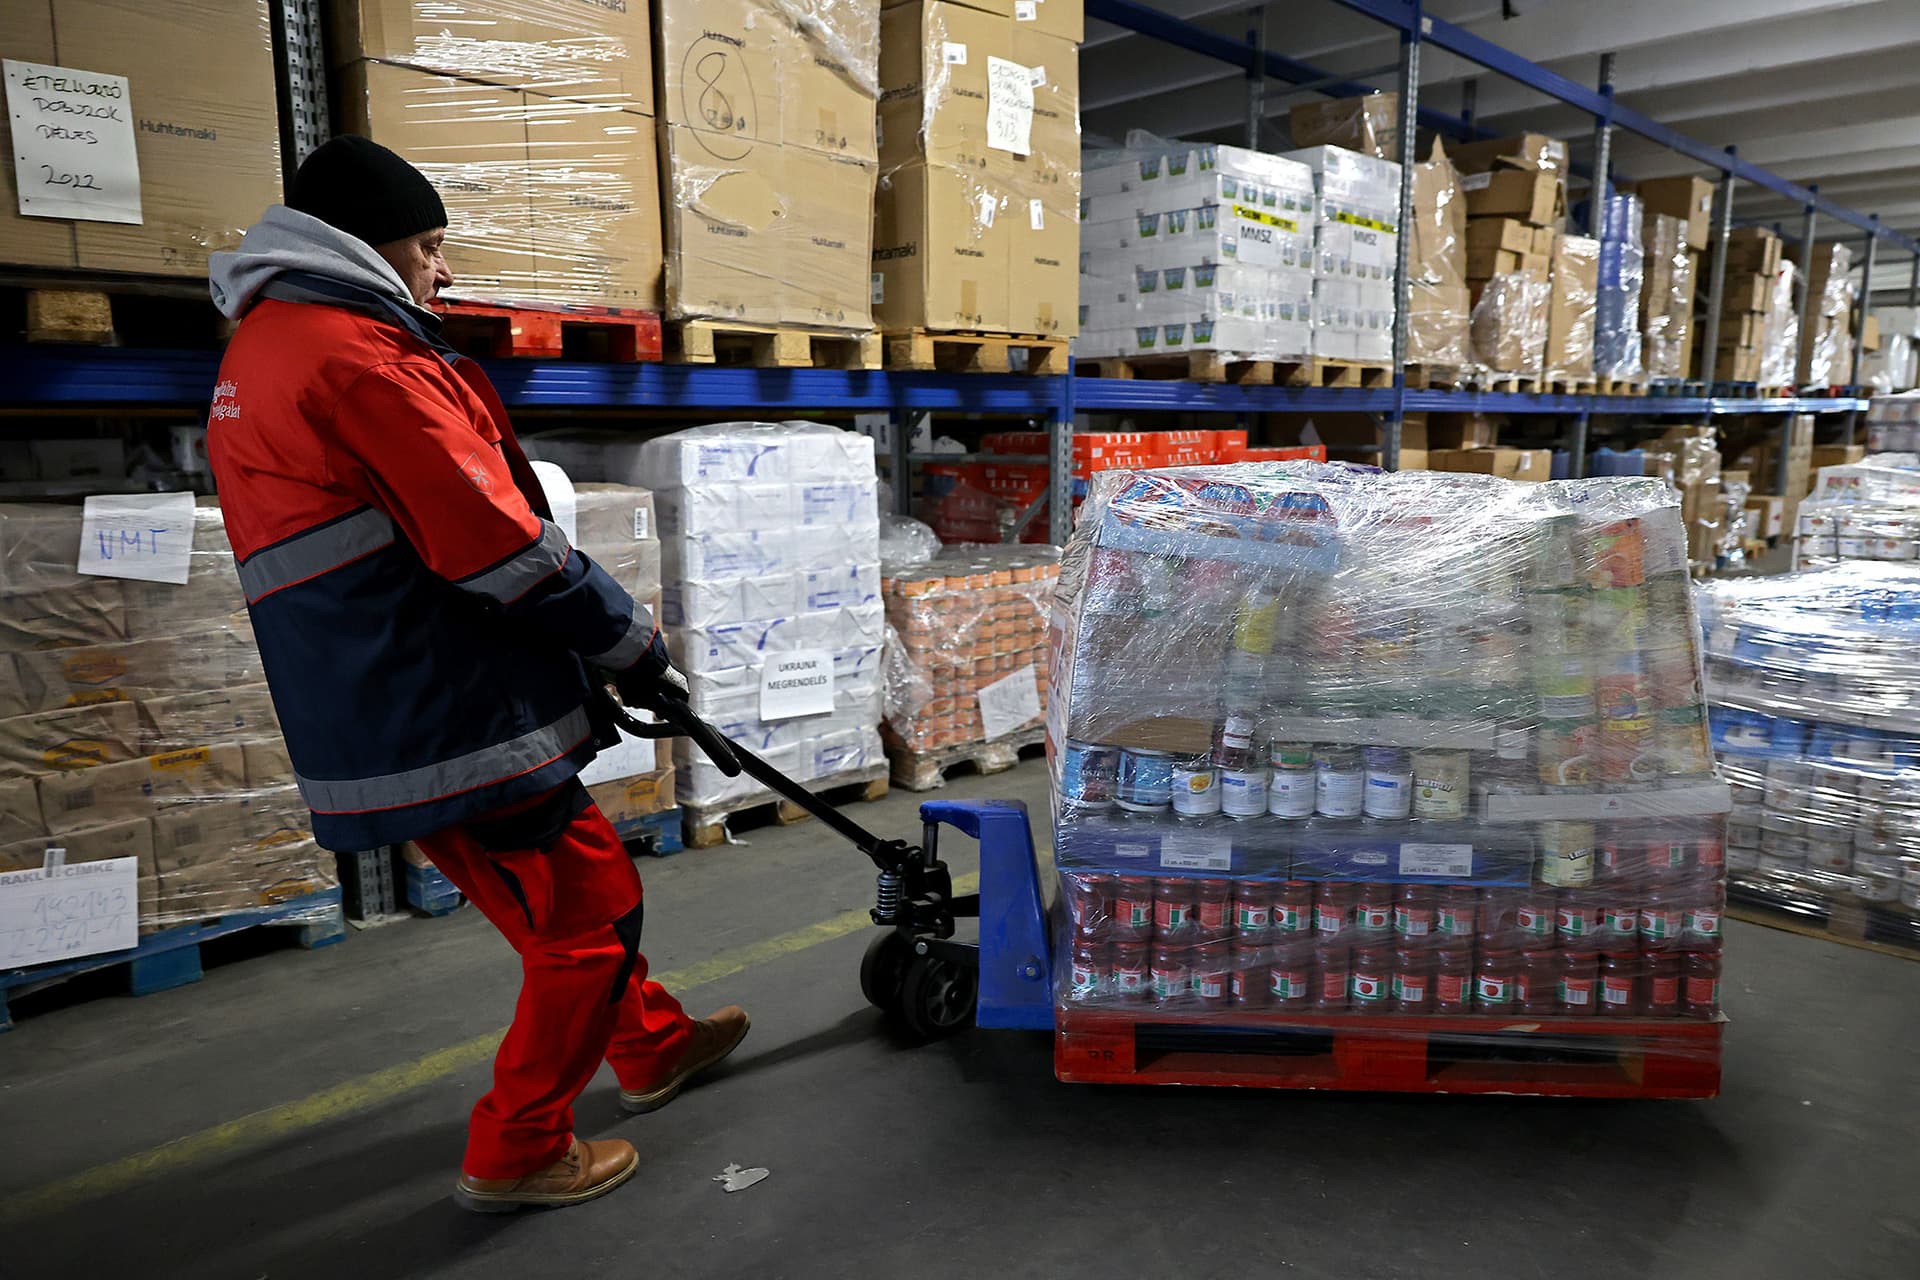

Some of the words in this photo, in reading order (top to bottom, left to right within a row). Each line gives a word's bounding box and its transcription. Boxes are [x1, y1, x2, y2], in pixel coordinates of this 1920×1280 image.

[32, 97, 124, 123] DOBOZOK
[139, 119, 218, 141] Huhtamaki
[40, 164, 104, 191] 2022
[1240, 224, 1274, 245] MMSZ
[98, 528, 168, 560] NMT
[767, 674, 829, 690] MEGRENDELÉS
